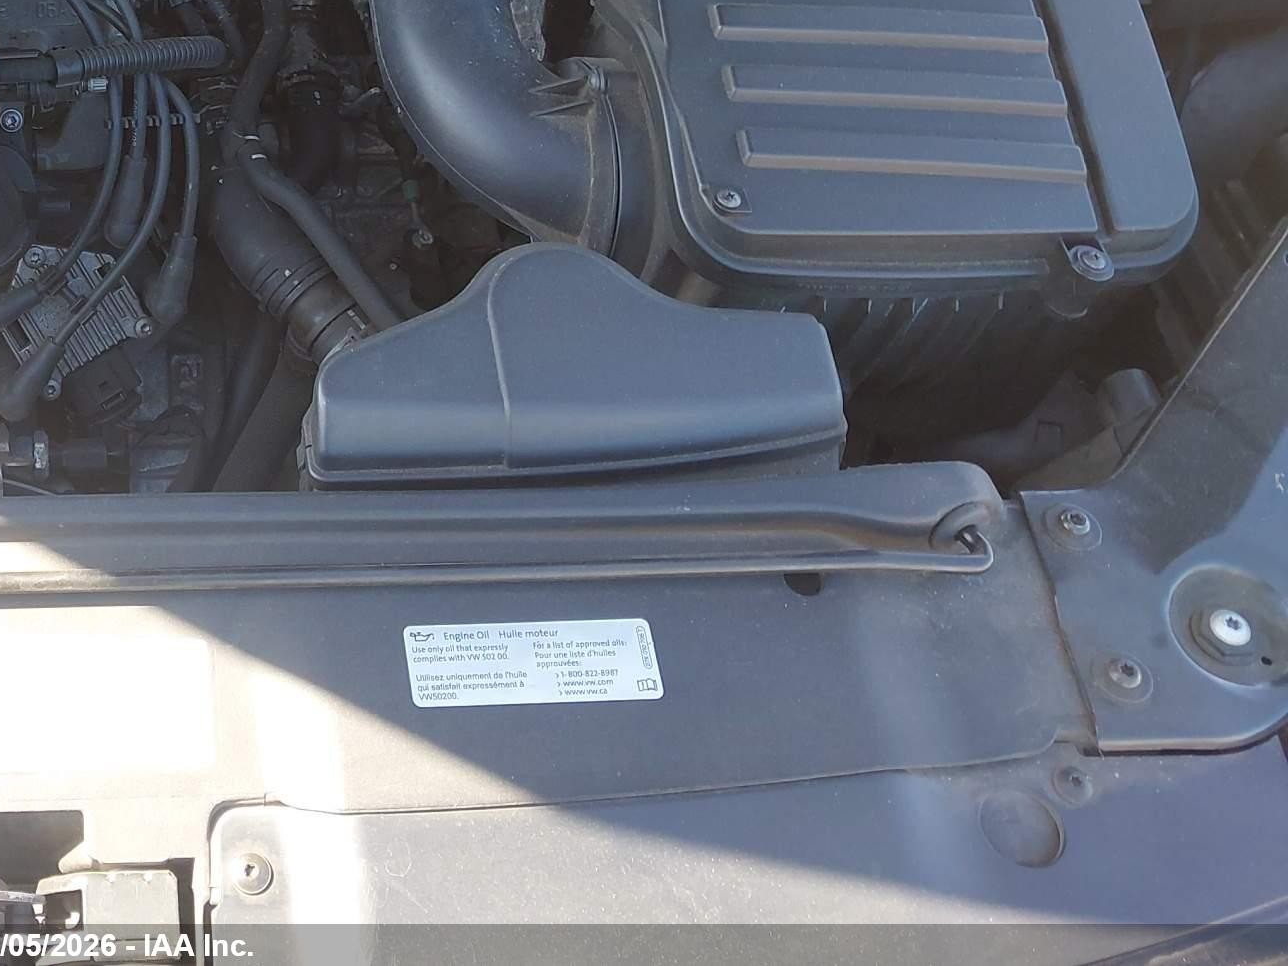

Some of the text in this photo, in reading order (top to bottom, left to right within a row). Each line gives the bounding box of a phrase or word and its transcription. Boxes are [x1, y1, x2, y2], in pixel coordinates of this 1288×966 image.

[443, 630, 490, 642] Engine Oil
[498, 629, 558, 639] Huile moteur
[411, 643, 509, 655] Use only oil that expressly
[532, 640, 545, 649] For
[552, 640, 564, 649] list
[565, 640, 574, 648] of
[575, 639, 610, 649] approved
[413, 654, 447, 664] complies
[448, 653, 466, 662] with
[467, 653, 481, 661] VW
[482, 652, 496, 661] 502
[534, 650, 552, 659] Pour
[569, 649, 585, 658] liste
[587, 648, 617, 658] d'huiles
[415, 670, 528, 682] Utilisez uniquement de l'huile
[417, 679, 525, 692] qui satisfait expressément à
[562, 678, 614, 686] www.vw.com
[564, 688, 608, 696] www.vw.ca
